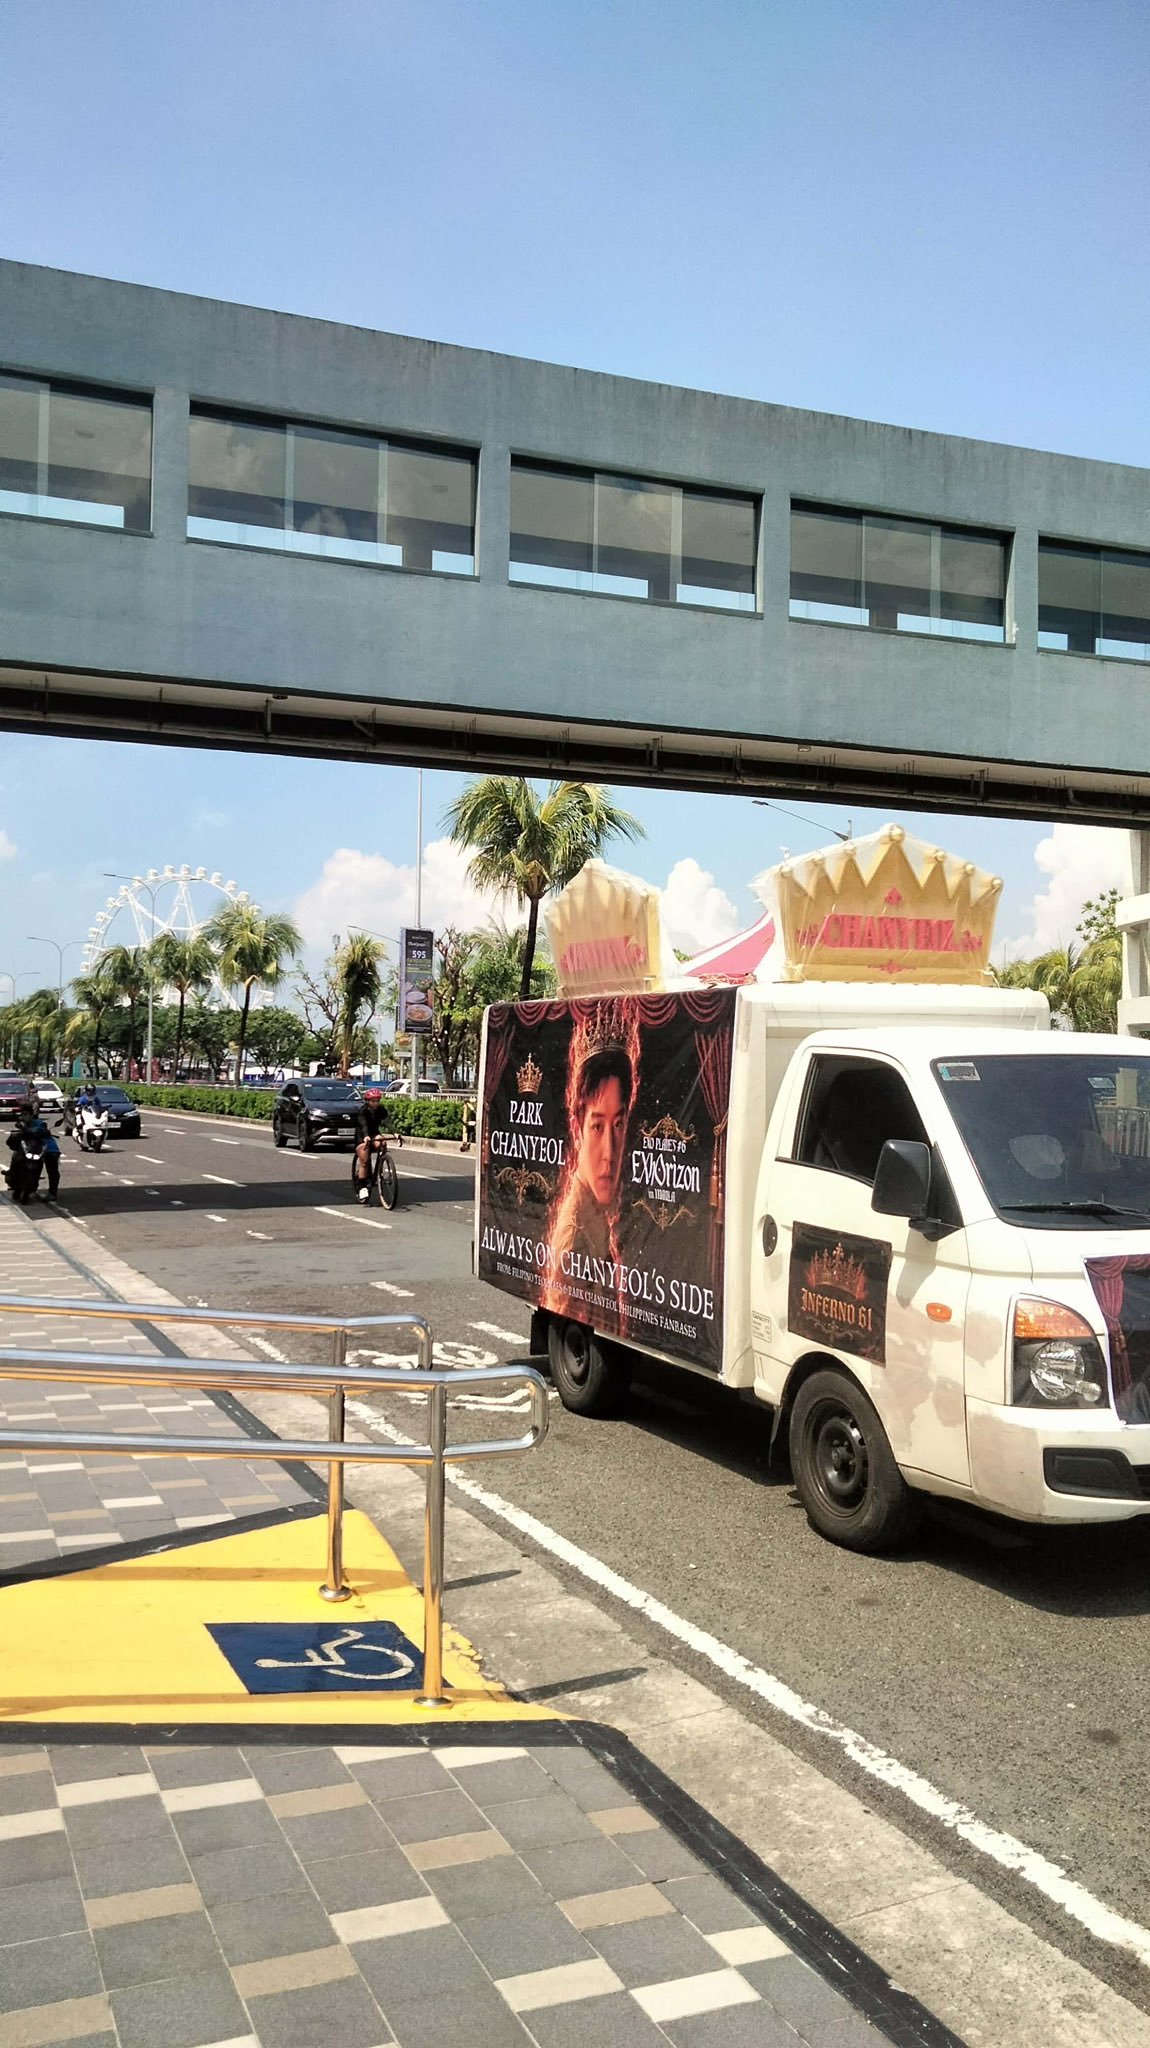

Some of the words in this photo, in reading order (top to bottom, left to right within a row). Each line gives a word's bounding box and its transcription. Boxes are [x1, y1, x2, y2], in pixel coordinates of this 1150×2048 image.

[412, 950, 426, 959] 595
[509, 1100, 544, 1126] PARK
[490, 1130, 566, 1166] CHANYEOL
[481, 1225, 533, 1264] ALWAYS
[535, 1241, 557, 1269] ON
[560, 1249, 665, 1305] CHANYEOL'S
[669, 1279, 715, 1321] SIDE
[512, 1266, 534, 1283] FILIPINO
[567, 1284, 584, 1300] PARK
[584, 1290, 618, 1312] CHANYEOL
[619, 1302, 659, 1327] PHILIPPINES
[659, 1315, 697, 1339] FANBASES
[801, 1287, 855, 1325] INFERNO
[858, 1305, 873, 1332] 61
